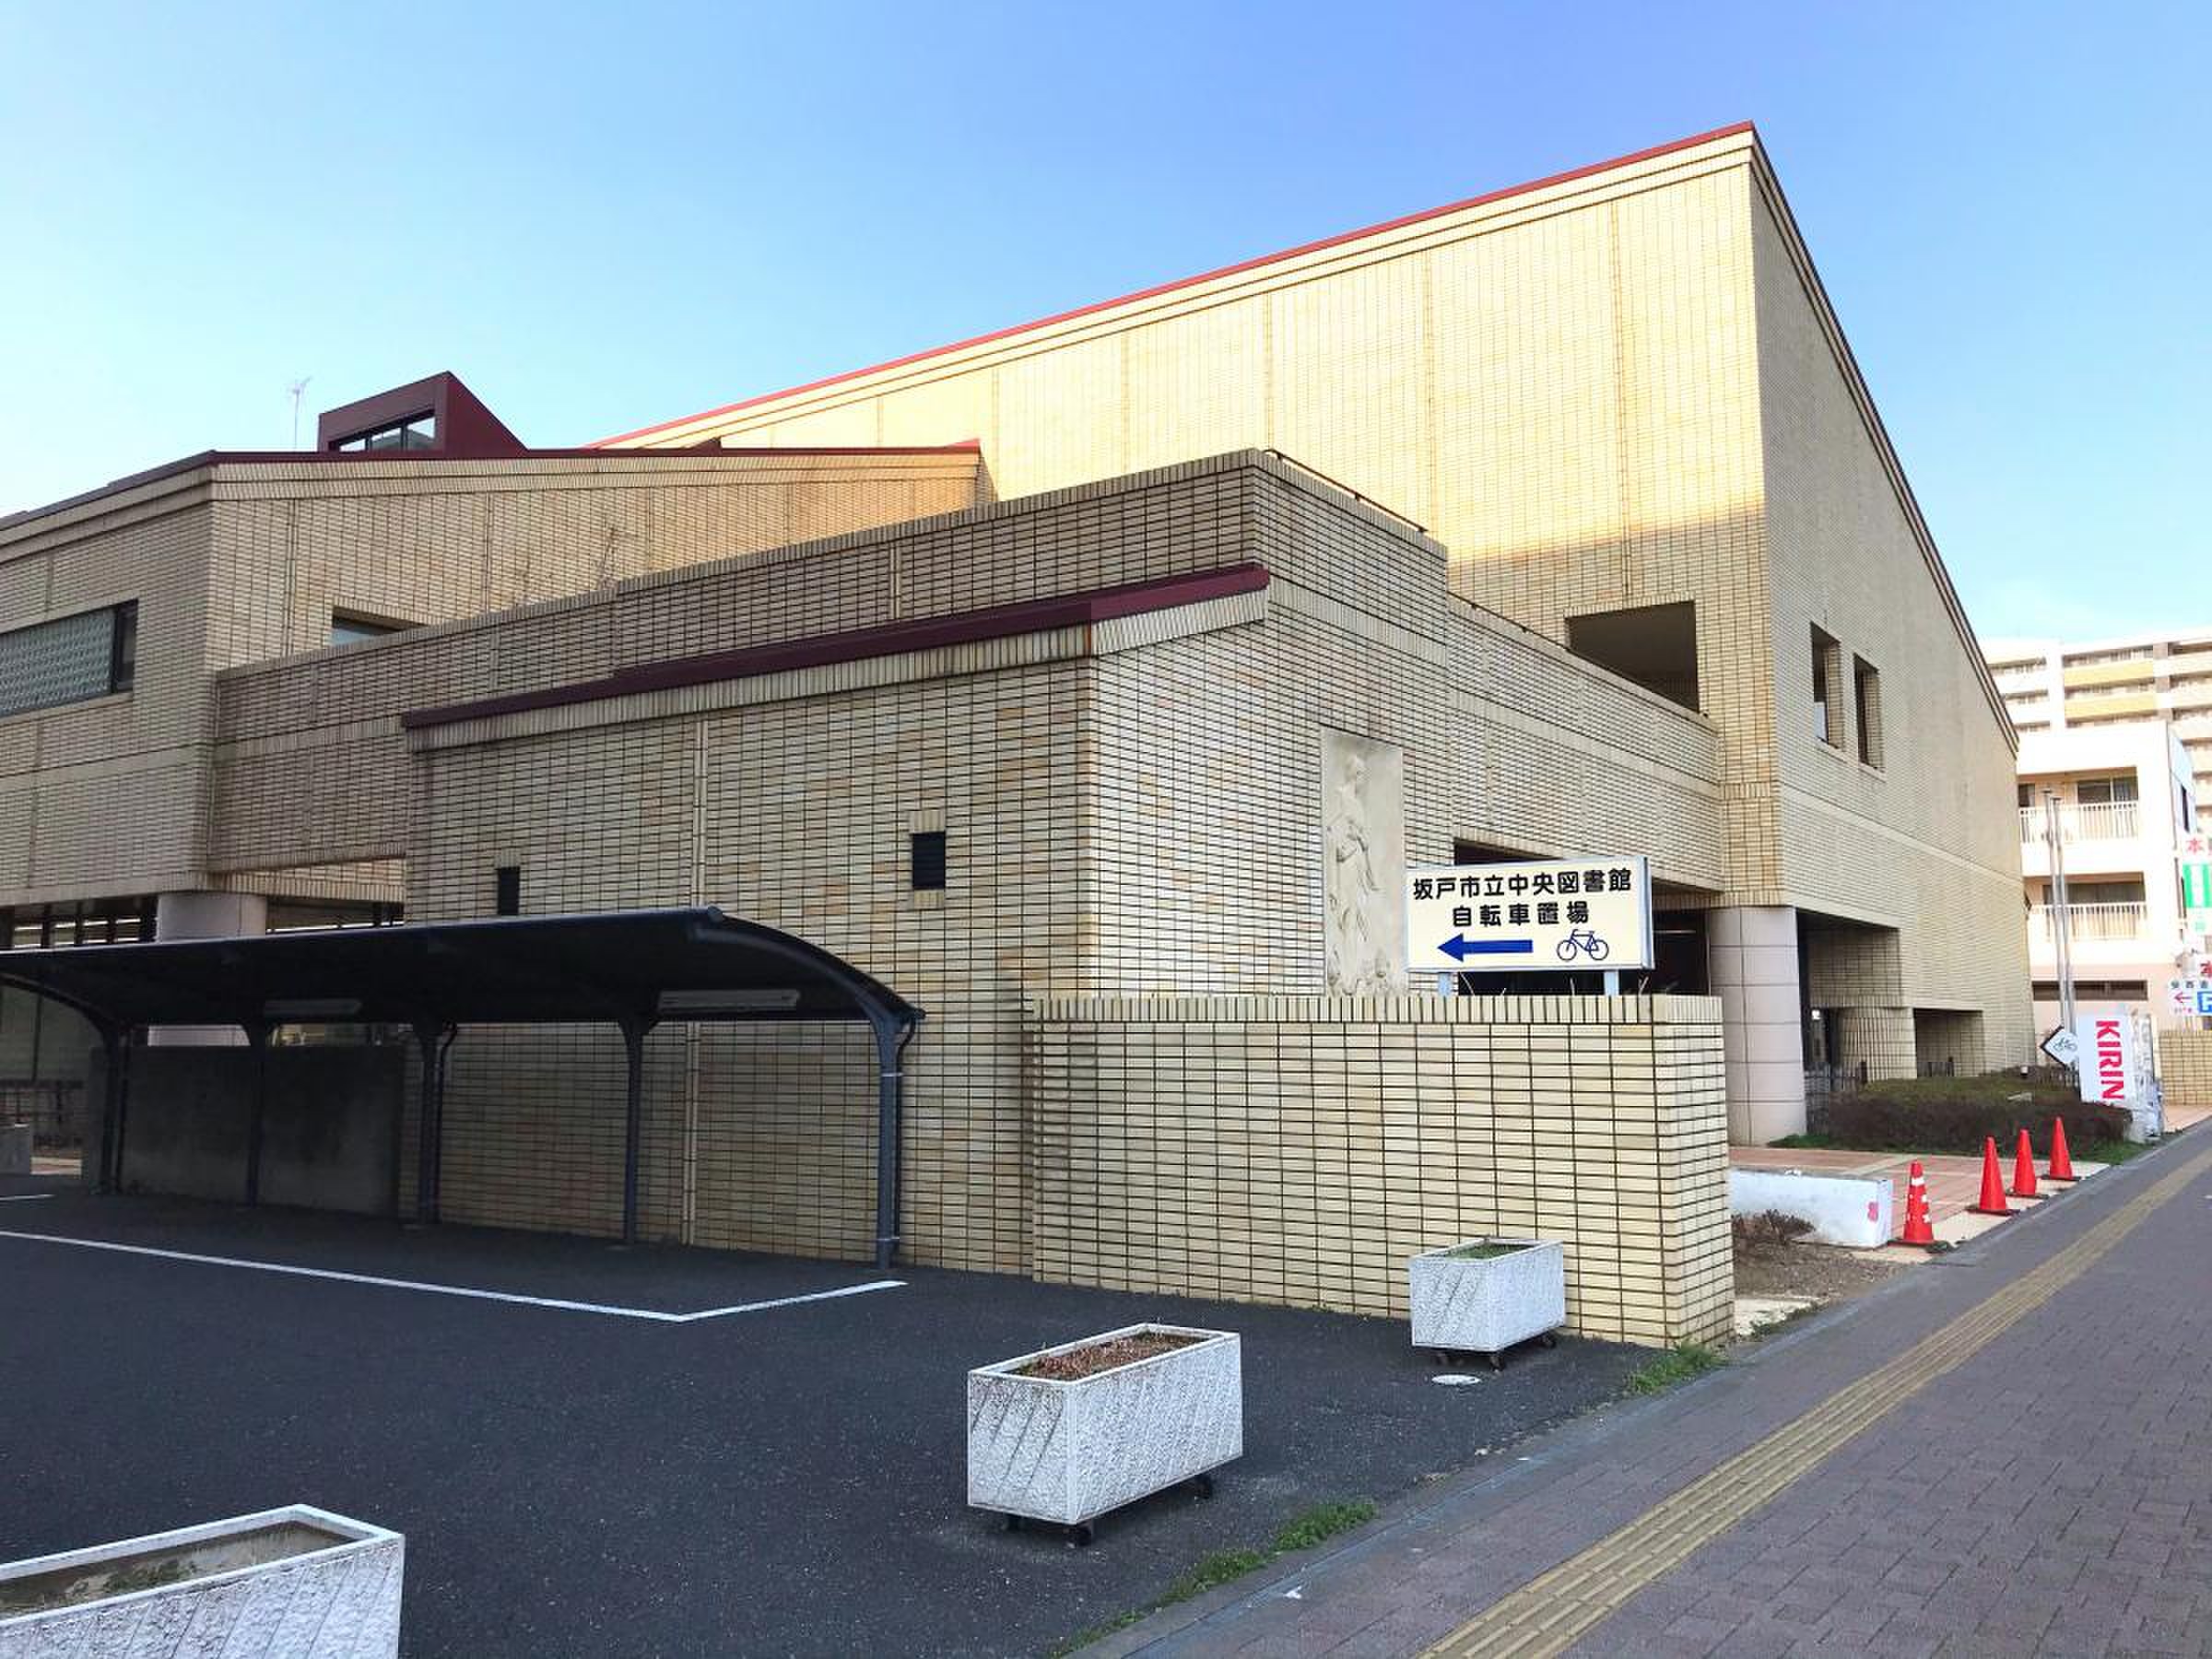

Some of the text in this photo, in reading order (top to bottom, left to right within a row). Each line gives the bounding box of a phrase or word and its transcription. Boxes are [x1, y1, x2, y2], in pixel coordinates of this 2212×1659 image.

[1413, 868, 1631, 900] 坂戸市立中央図書館
[1453, 900, 1589, 927] 自転車置場
[2096, 1020, 2124, 1100] KIRIN
